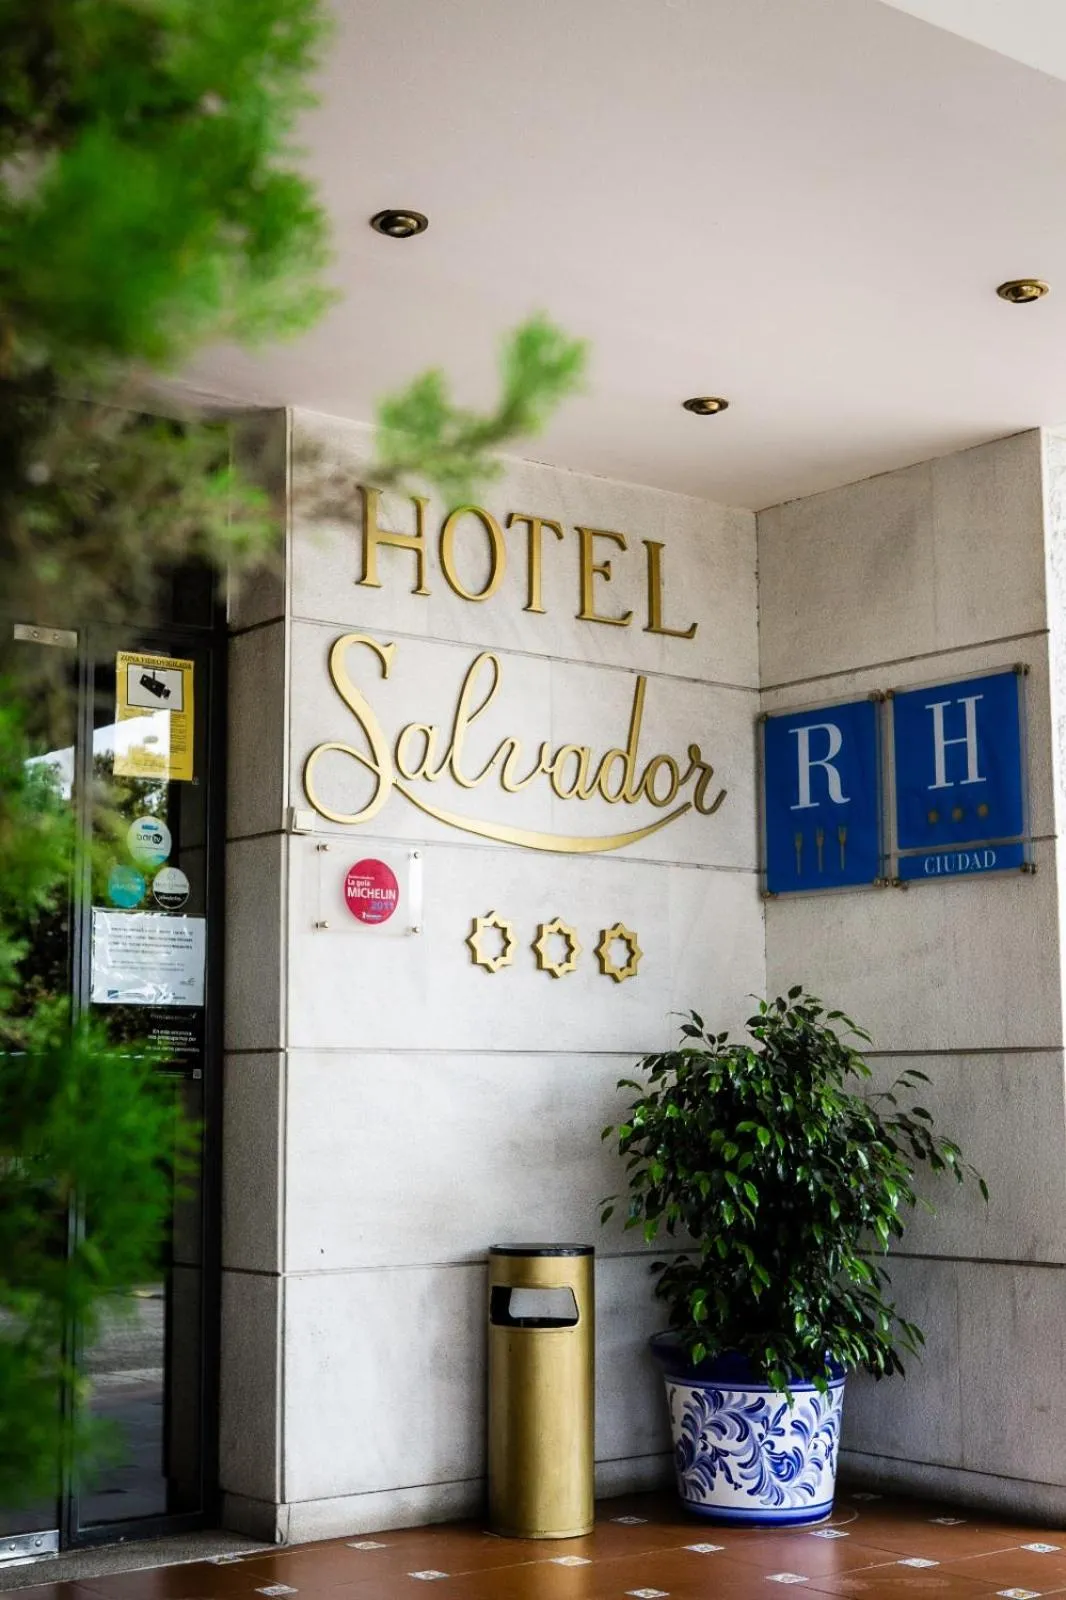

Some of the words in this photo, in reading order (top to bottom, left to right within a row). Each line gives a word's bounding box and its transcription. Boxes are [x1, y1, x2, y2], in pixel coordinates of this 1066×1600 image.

[355, 485, 699, 640] HOTEL
[303, 633, 728, 853] Salvador
[788, 722, 851, 812] R
[925, 694, 987, 791] H
[347, 887, 396, 900] MICHELIN
[924, 849, 997, 875] CIUDAD
